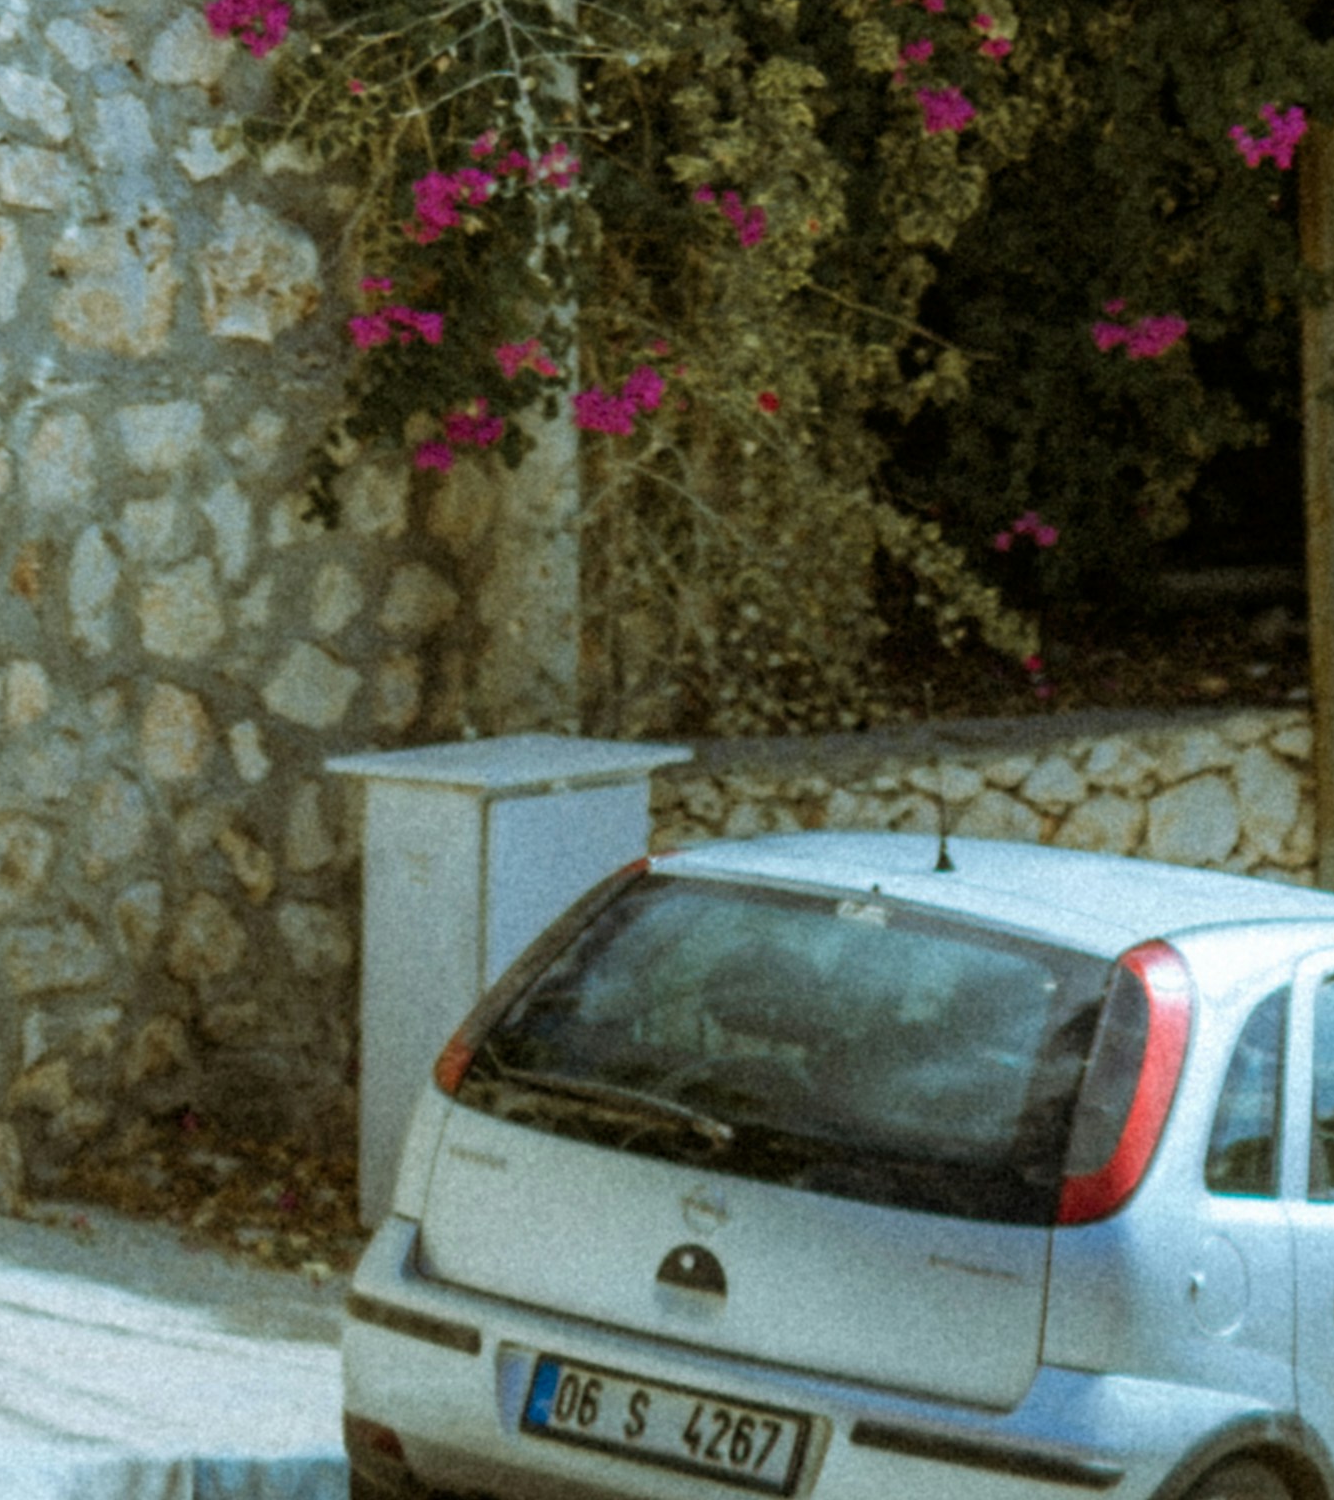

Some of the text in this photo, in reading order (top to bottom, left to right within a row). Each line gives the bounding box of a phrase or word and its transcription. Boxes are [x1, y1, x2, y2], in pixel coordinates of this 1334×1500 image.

[554, 1372, 782, 1474] 06 S 4267
